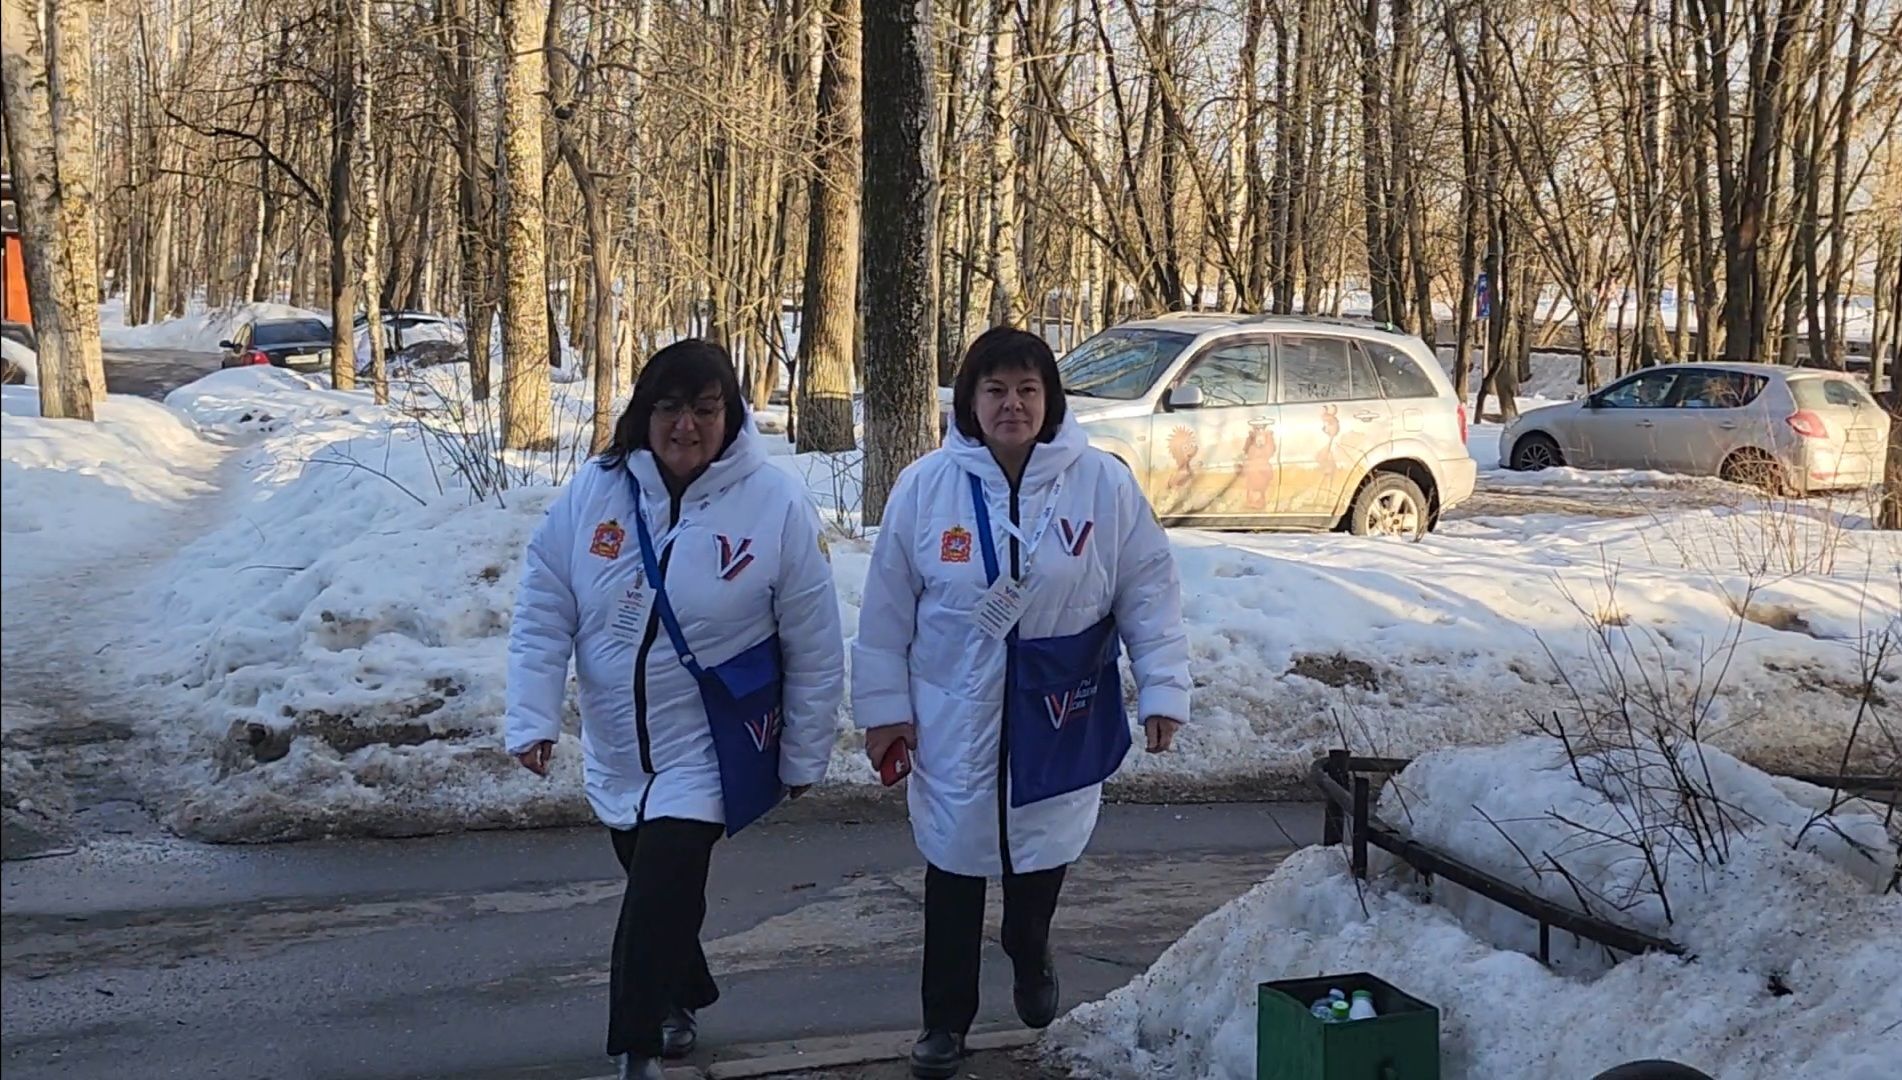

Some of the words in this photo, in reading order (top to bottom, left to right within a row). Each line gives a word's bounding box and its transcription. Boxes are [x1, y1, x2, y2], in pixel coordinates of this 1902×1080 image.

[1054, 517, 1094, 556] V
[712, 533, 756, 581] V
[1044, 690, 1071, 730] V
